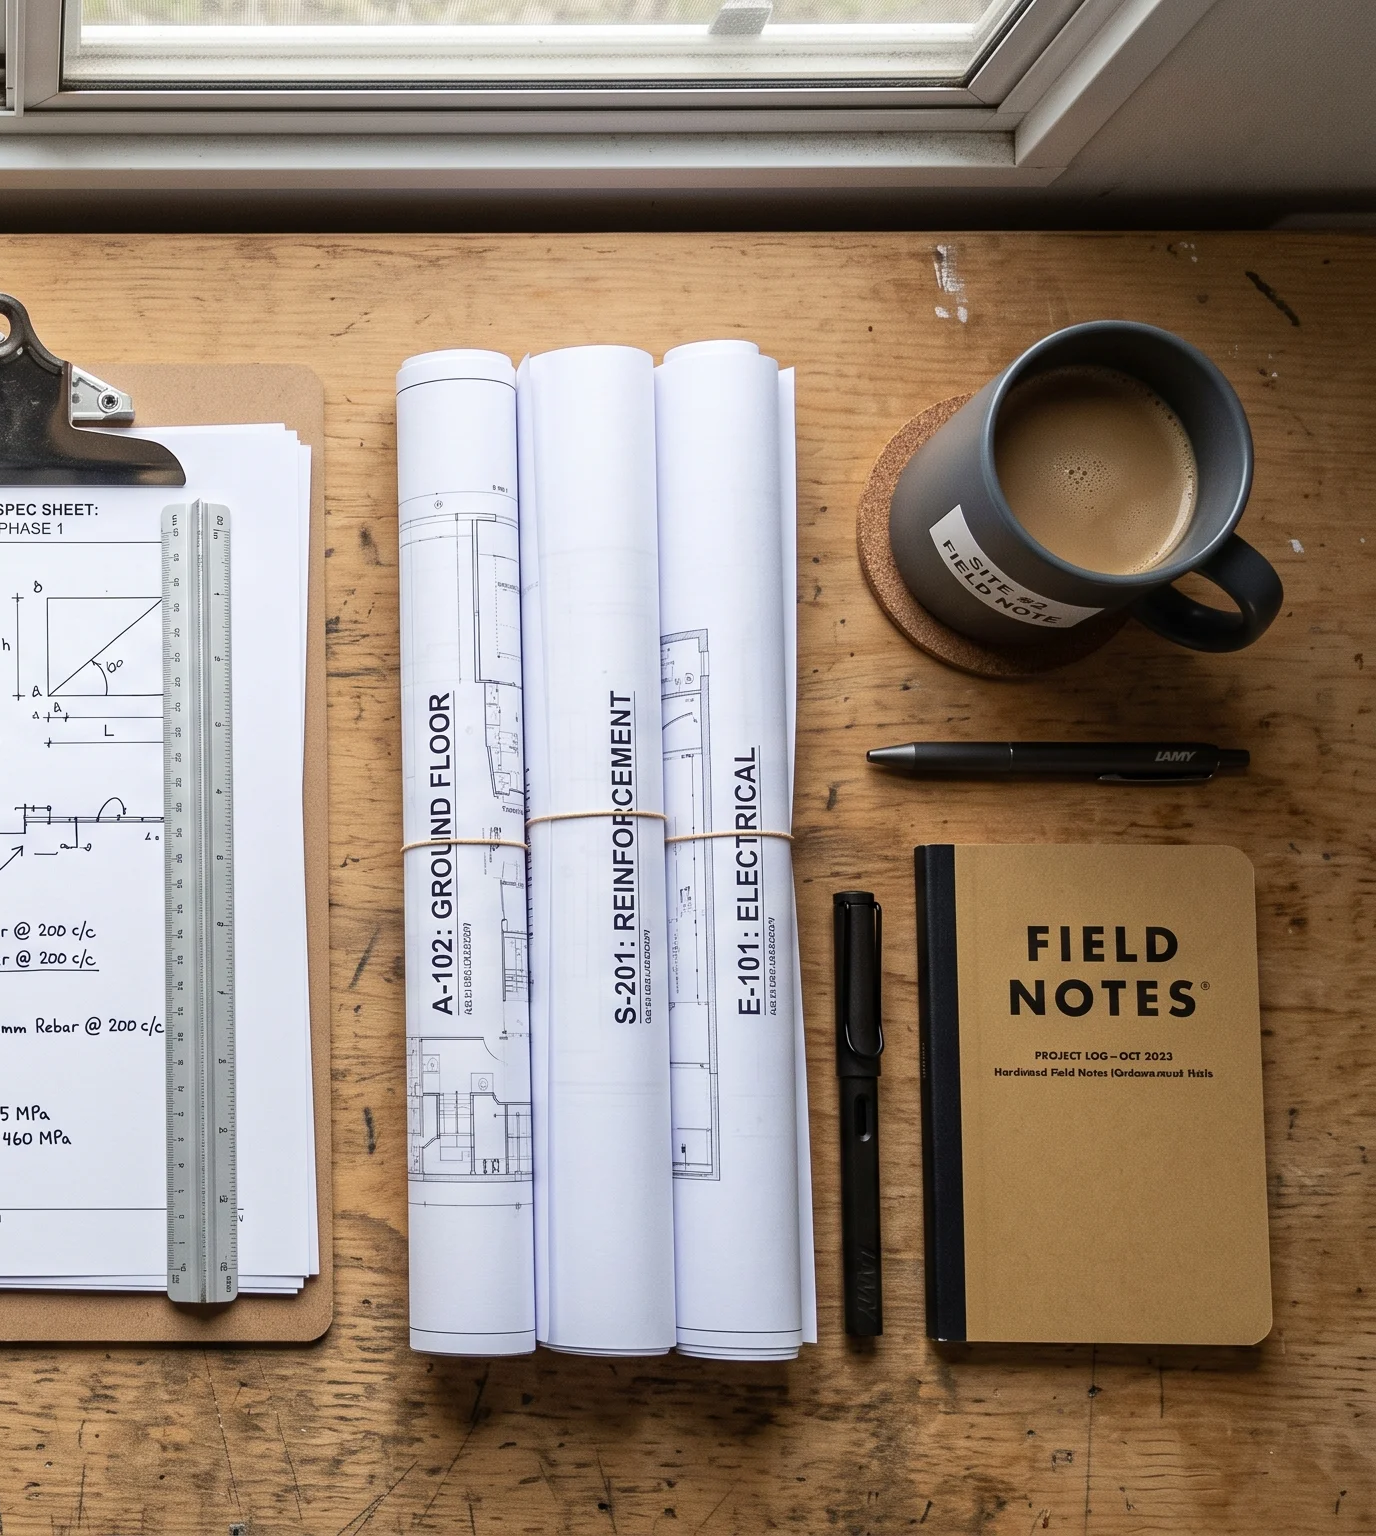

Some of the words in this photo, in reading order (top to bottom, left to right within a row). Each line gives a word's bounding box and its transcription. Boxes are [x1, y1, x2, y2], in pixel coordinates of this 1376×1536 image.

[41, 503, 98, 516] SHEET:
[57, 522, 63, 535] 1
[942, 539, 992, 596] FIELD
[995, 597, 1063, 624] NOTE
[969, 556, 1014, 596] SITE
[1, 637, 11, 651] h
[104, 724, 115, 737] L
[428, 692, 451, 788] FLOOR
[1155, 750, 1197, 763] LAMY
[611, 690, 634, 930] REINFORCEMENT
[734, 746, 758, 921] ELECTRICAL
[430, 794, 452, 920] GROUND
[13, 921, 31, 941] @
[38, 923, 67, 937] 200
[71, 920, 97, 941] c/c
[1027, 925, 1179, 963] FIELD
[15, 949, 31, 968] @
[39, 951, 67, 965] 200
[71, 948, 97, 969] c/c
[431, 930, 453, 1016] A-102:
[613, 941, 637, 1025] S-201:
[737, 932, 761, 1015] E-101:
[35, 1017, 80, 1034] Rebar
[84, 1016, 102, 1036] @
[108, 1018, 137, 1032] 200
[1035, 1051, 1082, 1061] PROJECT
[1085, 1051, 1109, 1061] LOG
[1119, 1051, 1141, 1061] OCT
[1144, 1051, 1173, 1061] 2023
[1077, 1068, 1108, 1078] Notes
[16, 1104, 51, 1121] MPa
[2, 1131, 33, 1146] 460
[39, 1129, 72, 1145] MPa
